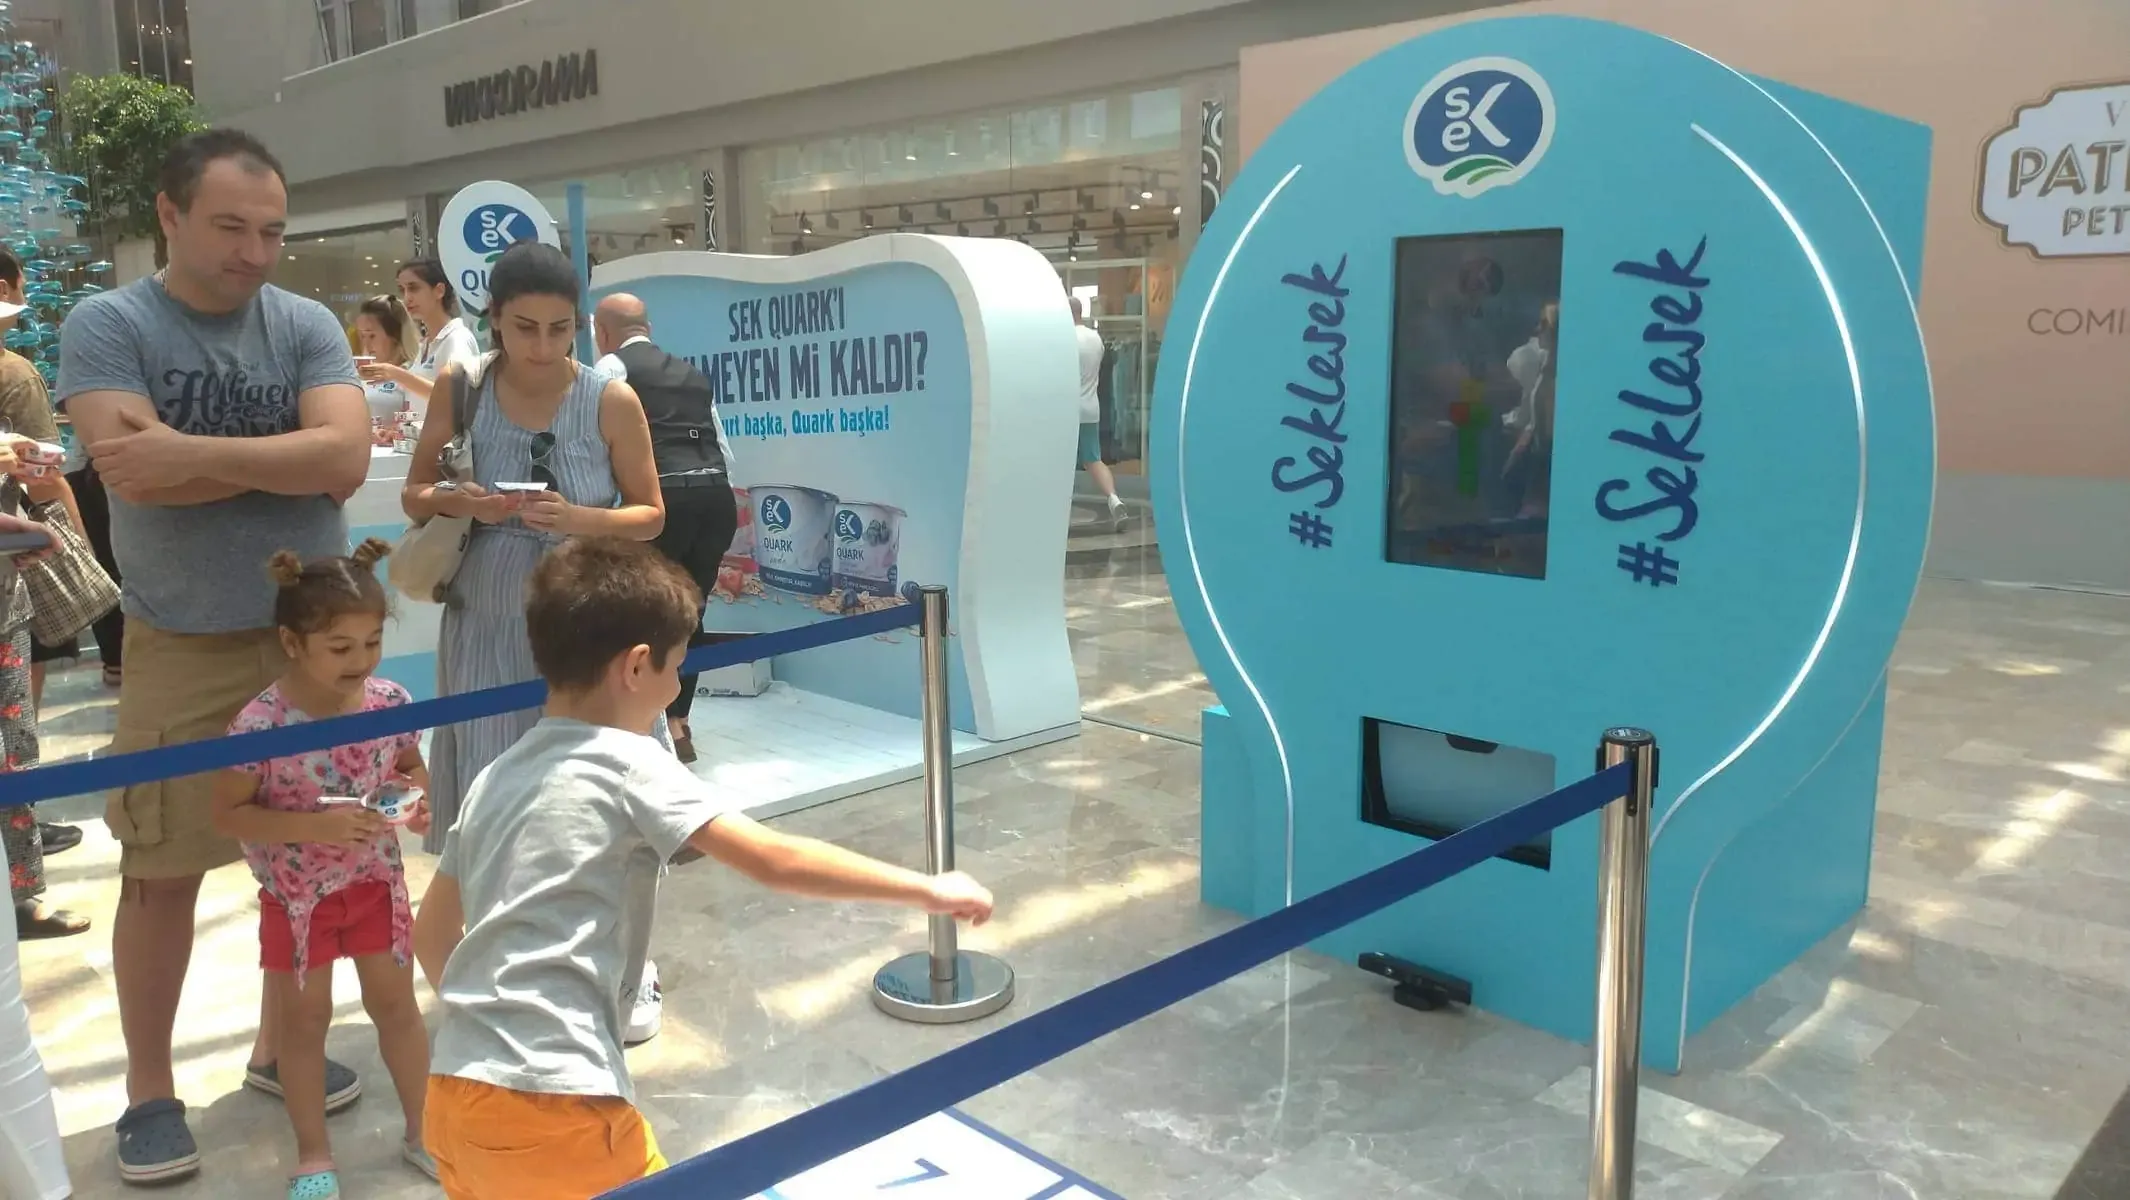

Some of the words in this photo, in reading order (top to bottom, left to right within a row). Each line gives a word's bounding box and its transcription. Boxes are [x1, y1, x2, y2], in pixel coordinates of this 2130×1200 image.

[2008, 140, 2130, 198] PAT
[728, 298, 763, 343] SEK
[682, 346, 781, 405] MEYEN
[829, 330, 929, 397] KALDI?
[744, 411, 787, 441] başka,
[791, 407, 834, 435] Quark
[839, 404, 890, 438] başka!
[763, 537, 794, 553] QUARK
[836, 547, 865, 561] QUARK
